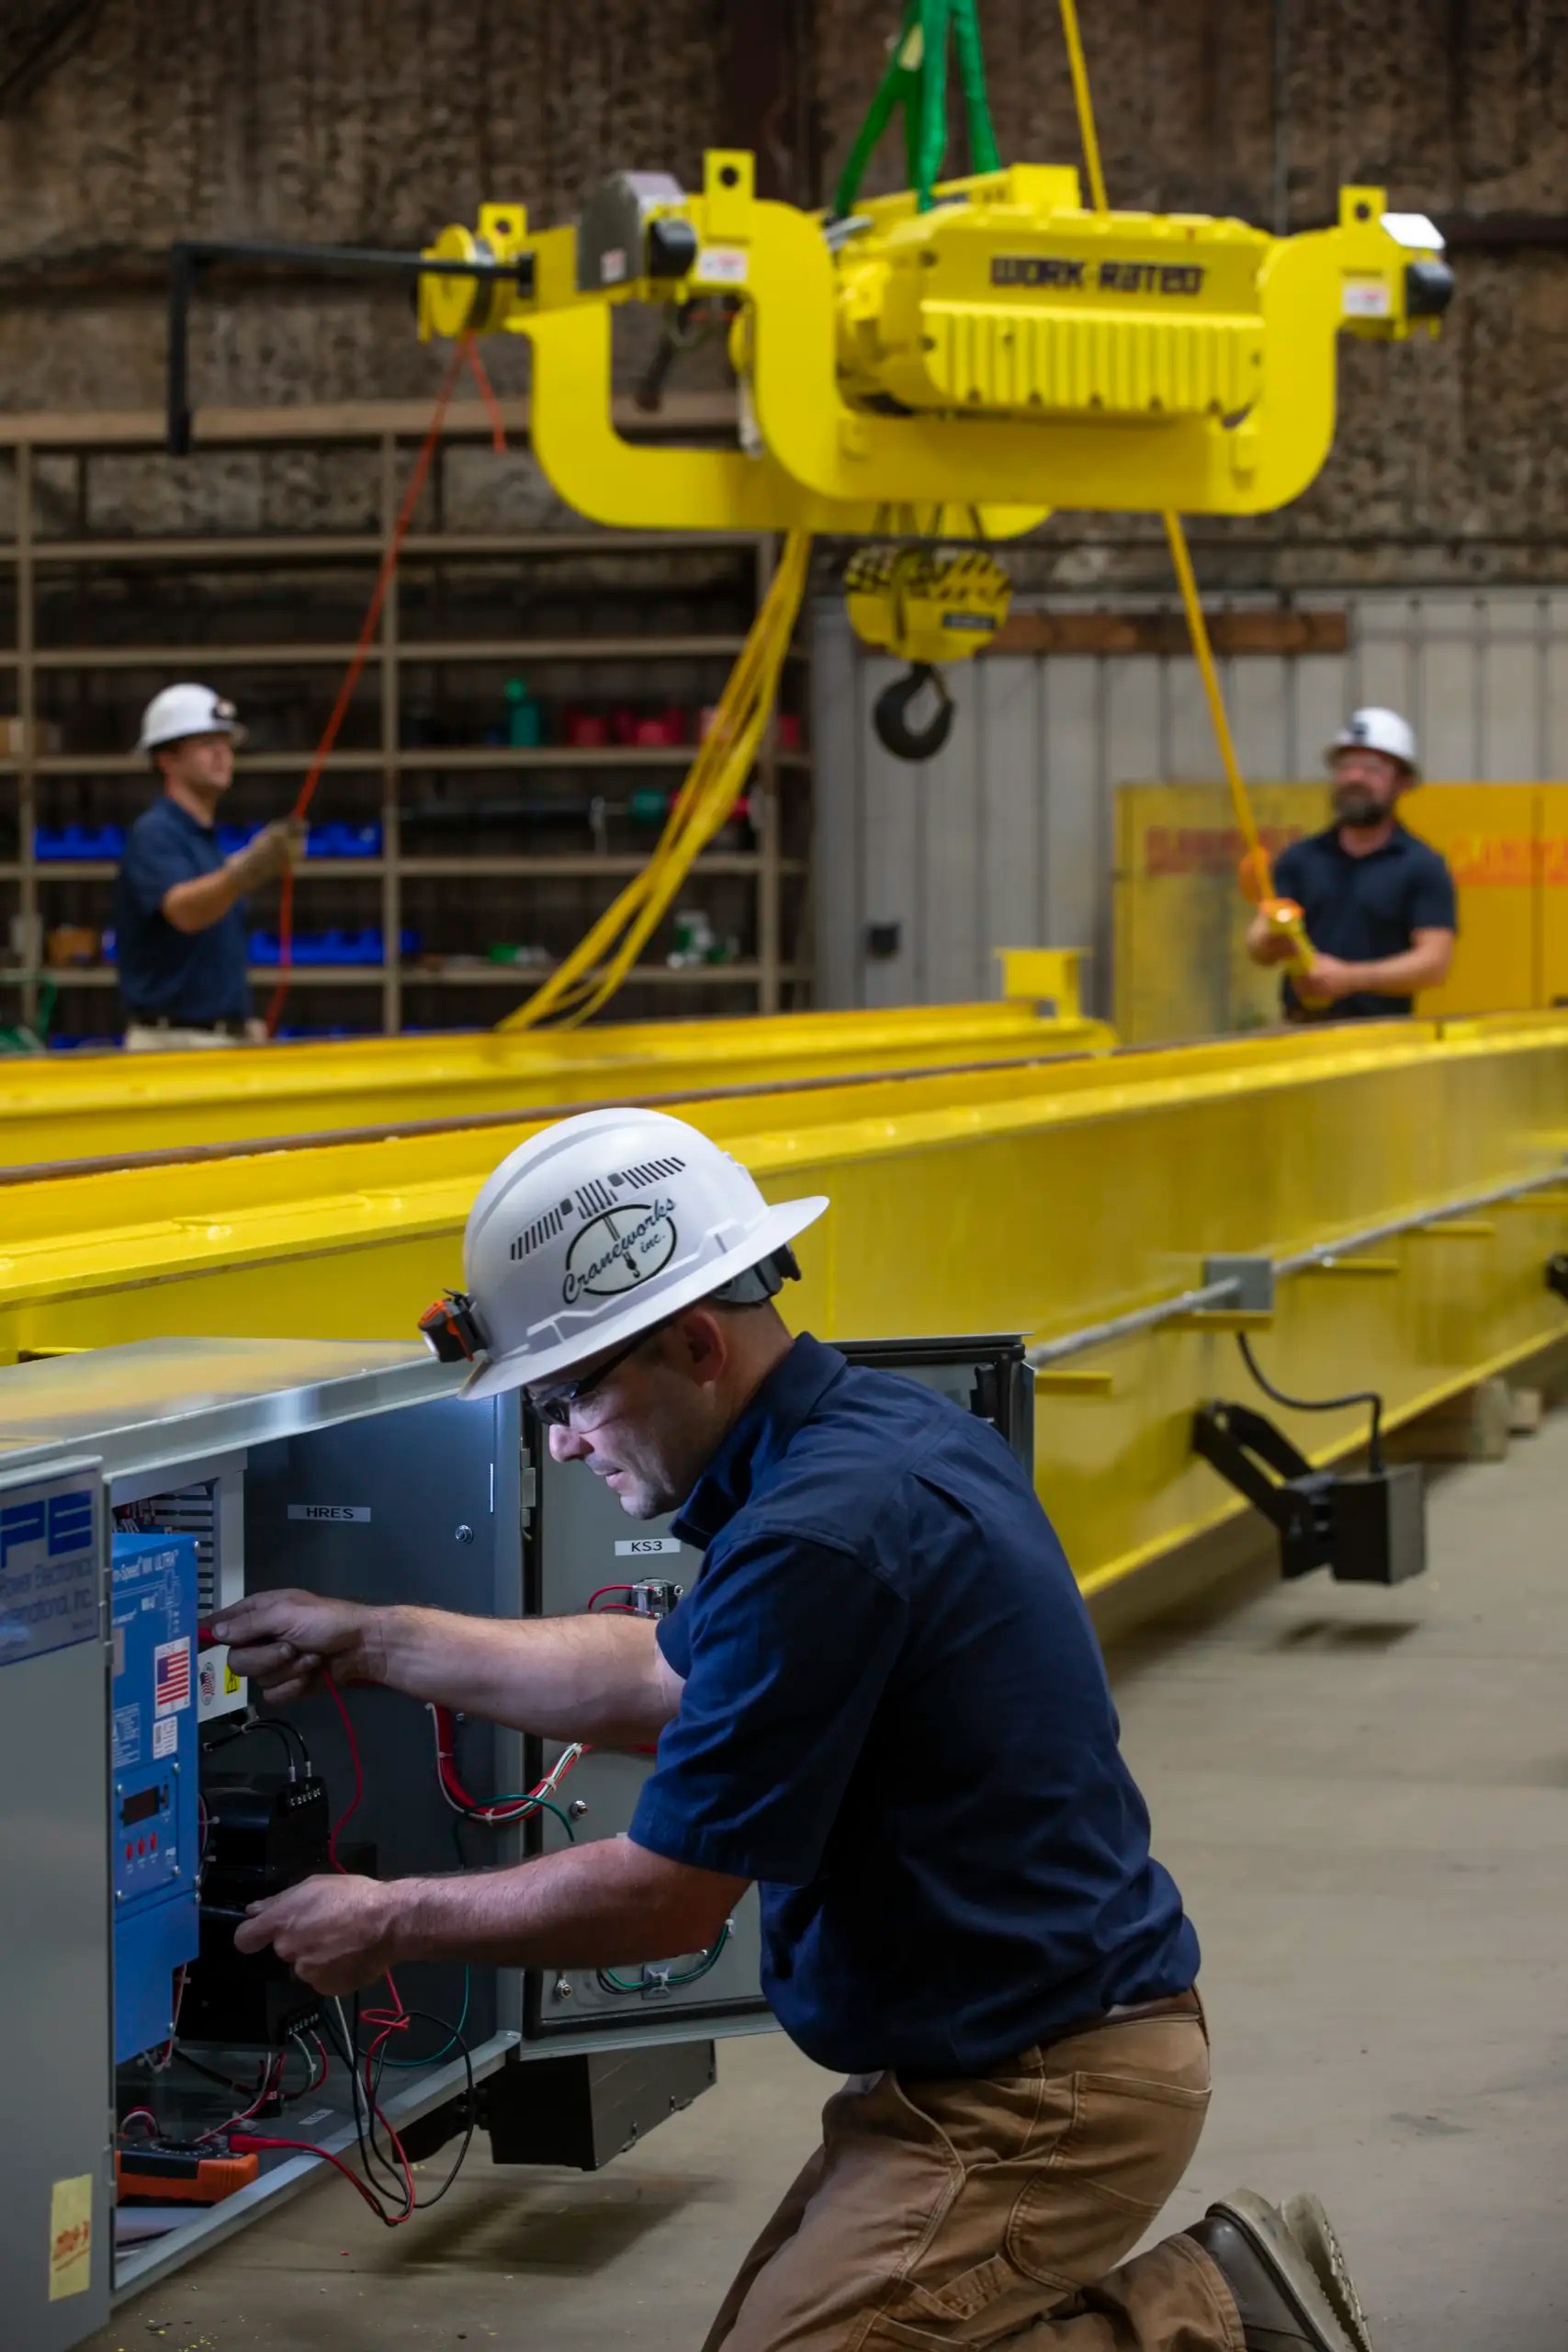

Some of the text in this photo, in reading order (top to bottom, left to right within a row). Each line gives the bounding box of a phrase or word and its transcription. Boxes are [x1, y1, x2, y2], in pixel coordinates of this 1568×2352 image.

[562, 1198, 675, 1305] Craneworks
[640, 1234, 666, 1254] inc.
[306, 1507, 355, 1519] HRES
[631, 1541, 663, 1553] KS3
